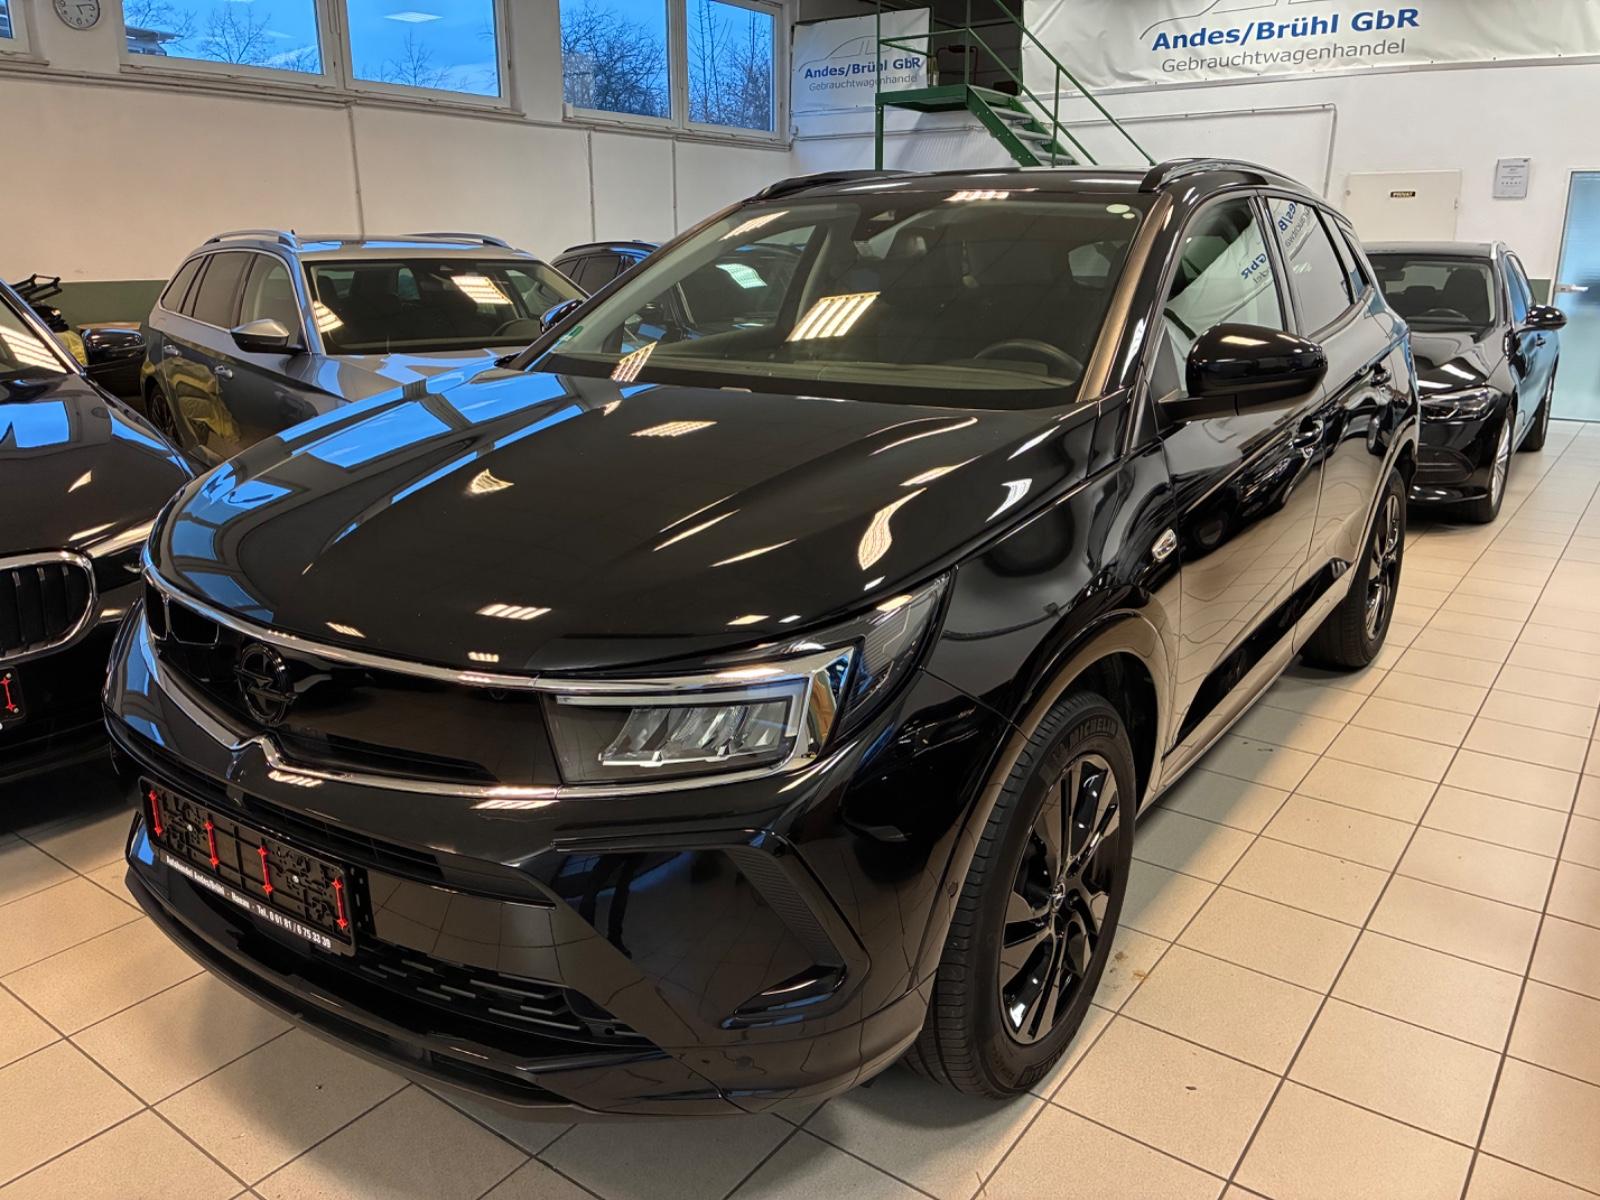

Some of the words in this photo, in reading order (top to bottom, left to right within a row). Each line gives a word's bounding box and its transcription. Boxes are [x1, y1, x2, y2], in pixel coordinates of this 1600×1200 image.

[1151, 14, 1339, 51] Andes/Brühl
[1351, 8, 1420, 32] GbR
[893, 57, 922, 70] GbR
[1161, 38, 1406, 73] Gebrauchtwagenhandel
